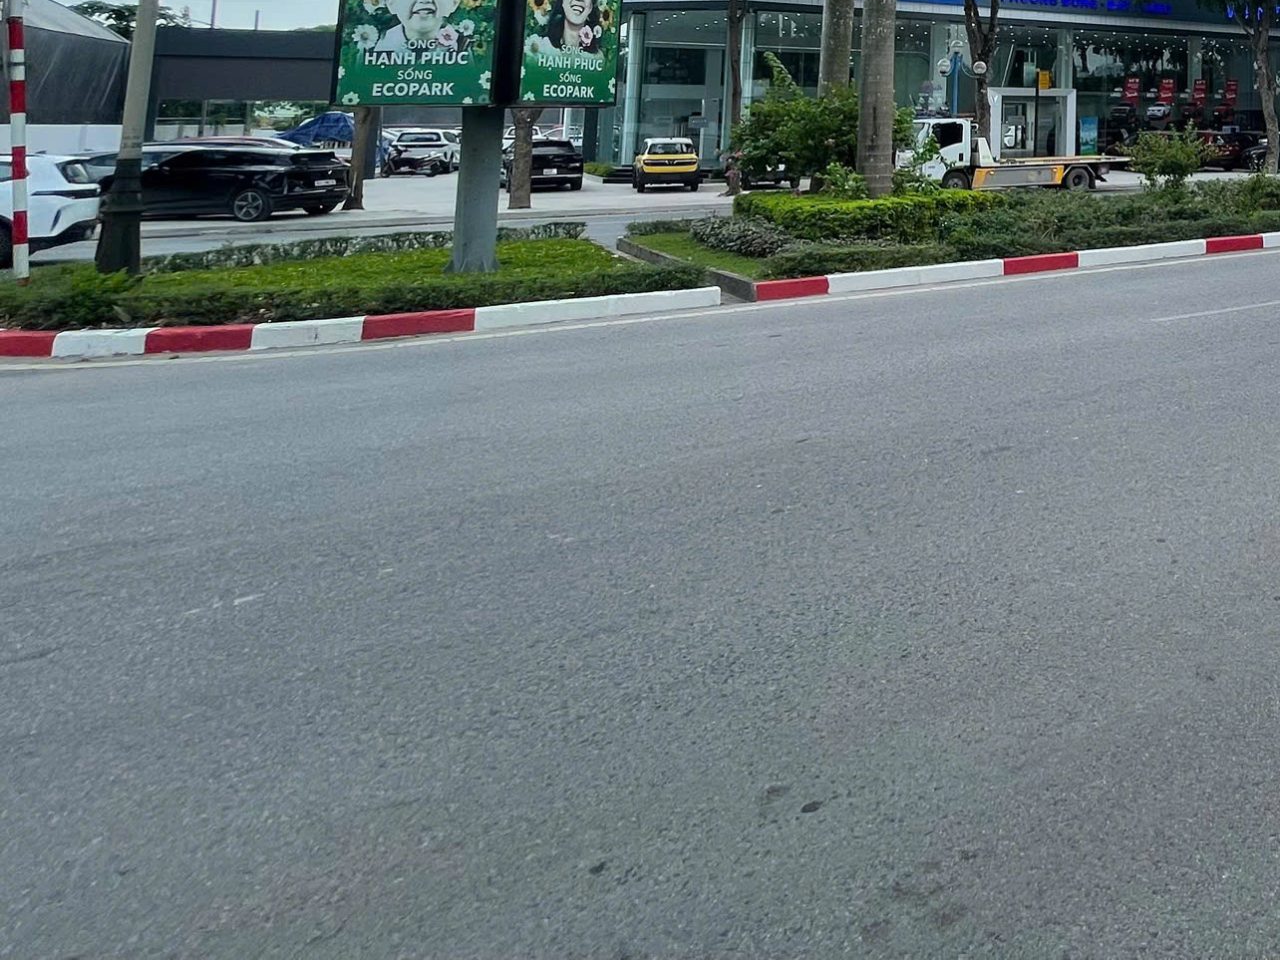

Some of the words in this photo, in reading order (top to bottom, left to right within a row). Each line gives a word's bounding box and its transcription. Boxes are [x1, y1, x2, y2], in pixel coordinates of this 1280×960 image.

[365, 52, 417, 69] HẠNH
[421, 48, 469, 65] PHÚC
[538, 54, 571, 71] HẠNH
[372, 83, 454, 97] ECOPARK
[543, 84, 594, 98] ECOPARK
